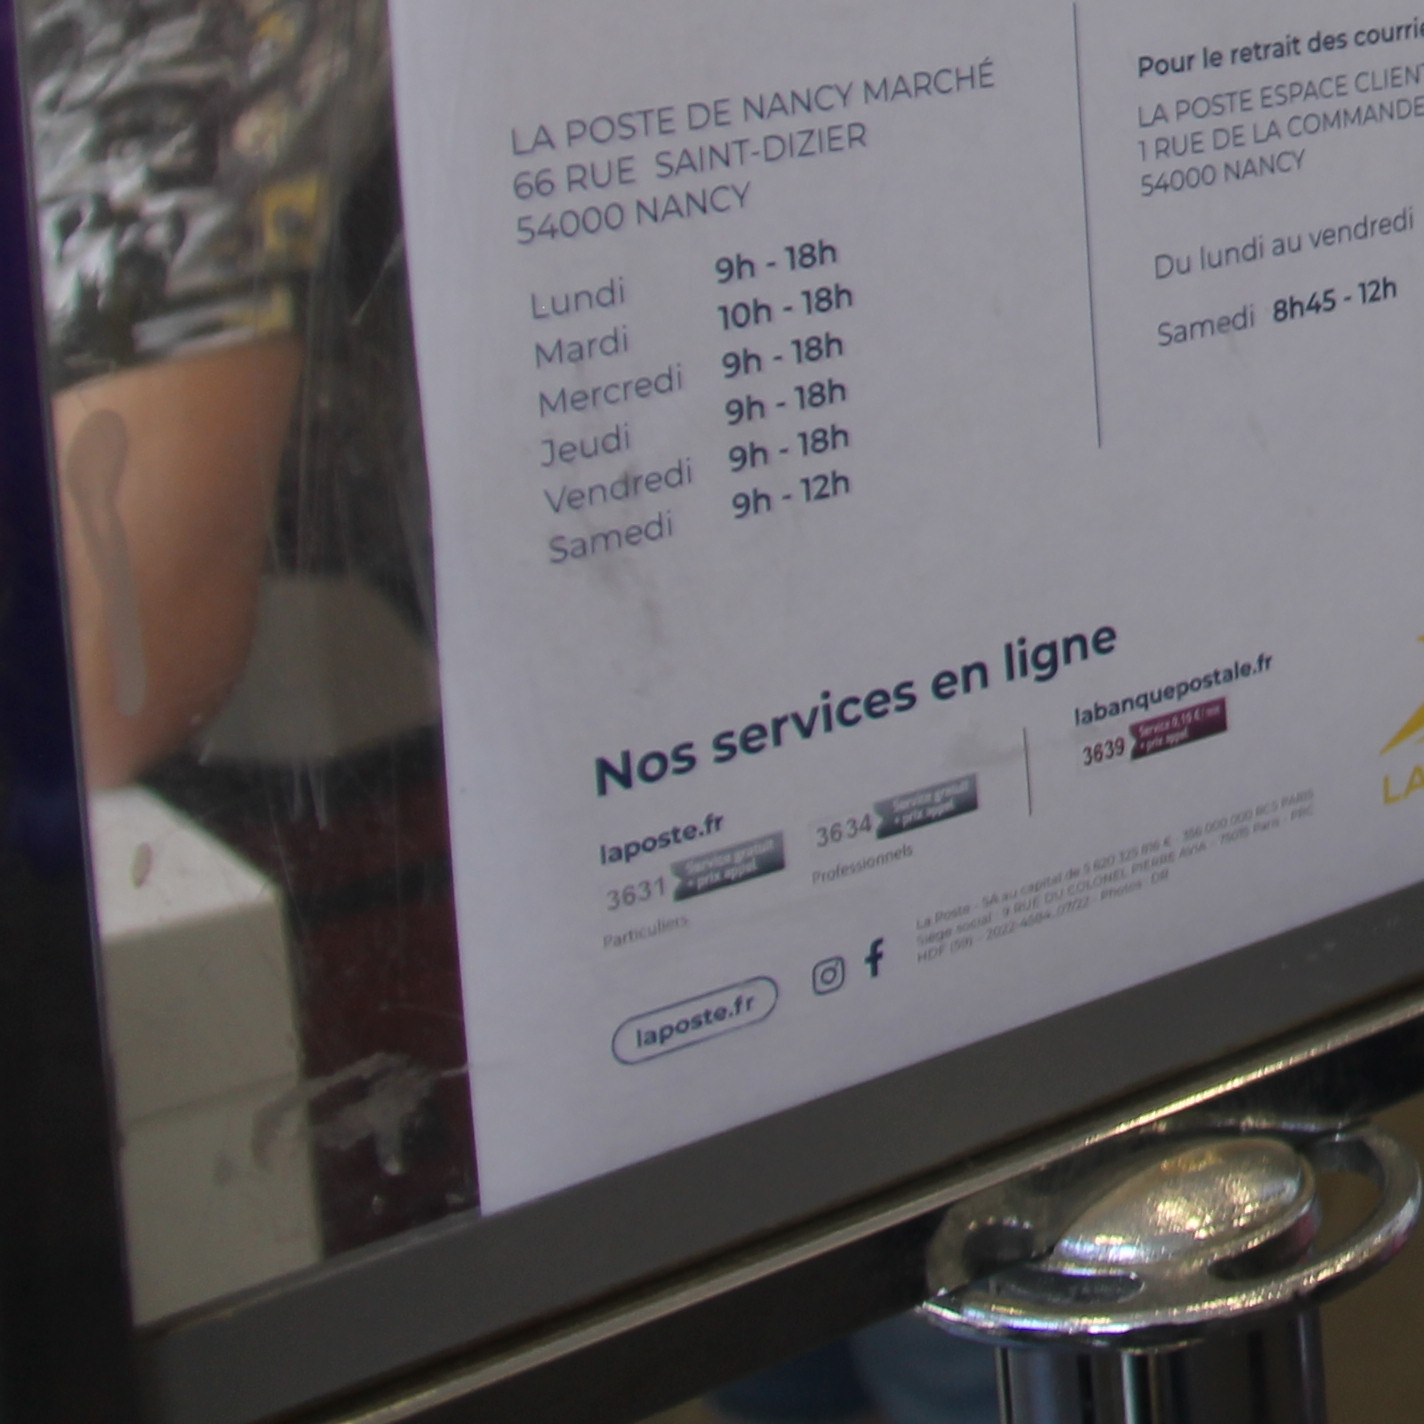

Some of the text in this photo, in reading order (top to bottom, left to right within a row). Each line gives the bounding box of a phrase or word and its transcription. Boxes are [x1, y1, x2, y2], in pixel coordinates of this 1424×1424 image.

[1138, 53, 1196, 78] Pour
[1202, 46, 1224, 69] le
[1230, 34, 1302, 65] retrait
[1307, 30, 1349, 54] des
[510, 56, 995, 157] LA POSTE DE NANCY MARCHÉ
[1138, 102, 1170, 129] LA
[1175, 88, 1254, 121] POSTE
[1259, 73, 1349, 110] ESPACE
[512, 121, 867, 201] 66 RUE SAINT-DIZIER
[1138, 139, 1147, 162] 1
[1154, 130, 1205, 160] RUE
[1212, 124, 1246, 152] DE
[1252, 119, 1282, 145] LA
[1140, 148, 1306, 198] 54000 NANCY
[517, 181, 751, 246] 54000 NANCY
[1154, 253, 1192, 281] Du
[1199, 234, 1265, 271] lundi
[1271, 234, 1303, 257] au
[1308, 206, 1415, 249] vendredi
[530, 275, 626, 321] Lundi
[715, 253, 756, 285] 9h
[784, 239, 838, 271] 18h
[534, 324, 629, 369] Mardi
[717, 297, 773, 331] 10h
[801, 282, 854, 315] 18h
[1157, 303, 1256, 348] Samedi
[1272, 288, 1337, 323] 8h45
[1357, 276, 1398, 305] 12h
[538, 362, 683, 418] Mercredi
[721, 347, 763, 379] 9h
[791, 331, 844, 365] 18h
[541, 422, 631, 468] Jeudi
[725, 394, 766, 426] 9h
[794, 377, 847, 410] 18h
[544, 457, 693, 514] Vendredi
[728, 441, 769, 473] 9h
[797, 423, 850, 457] 18h
[548, 511, 673, 565] Samedi
[731, 487, 772, 520] 9h
[800, 469, 851, 503] 12h
[595, 625, 1117, 797] Nos services en ligne
[1074, 653, 1272, 725] labanquepostale.fr
[1083, 737, 1126, 766] 3639
[1138, 720, 1170, 739] Service
[1146, 736, 1163, 753] prix
[1166, 730, 1189, 747] appel
[600, 813, 724, 865] laposte.fr
[817, 813, 873, 847] 3634
[812, 843, 913, 884] Professionnels
[607, 875, 666, 912] 3631
[935, 904, 971, 924] Poste
[602, 914, 689, 949] Particuliers
[636, 995, 755, 1048] laposte.fr
